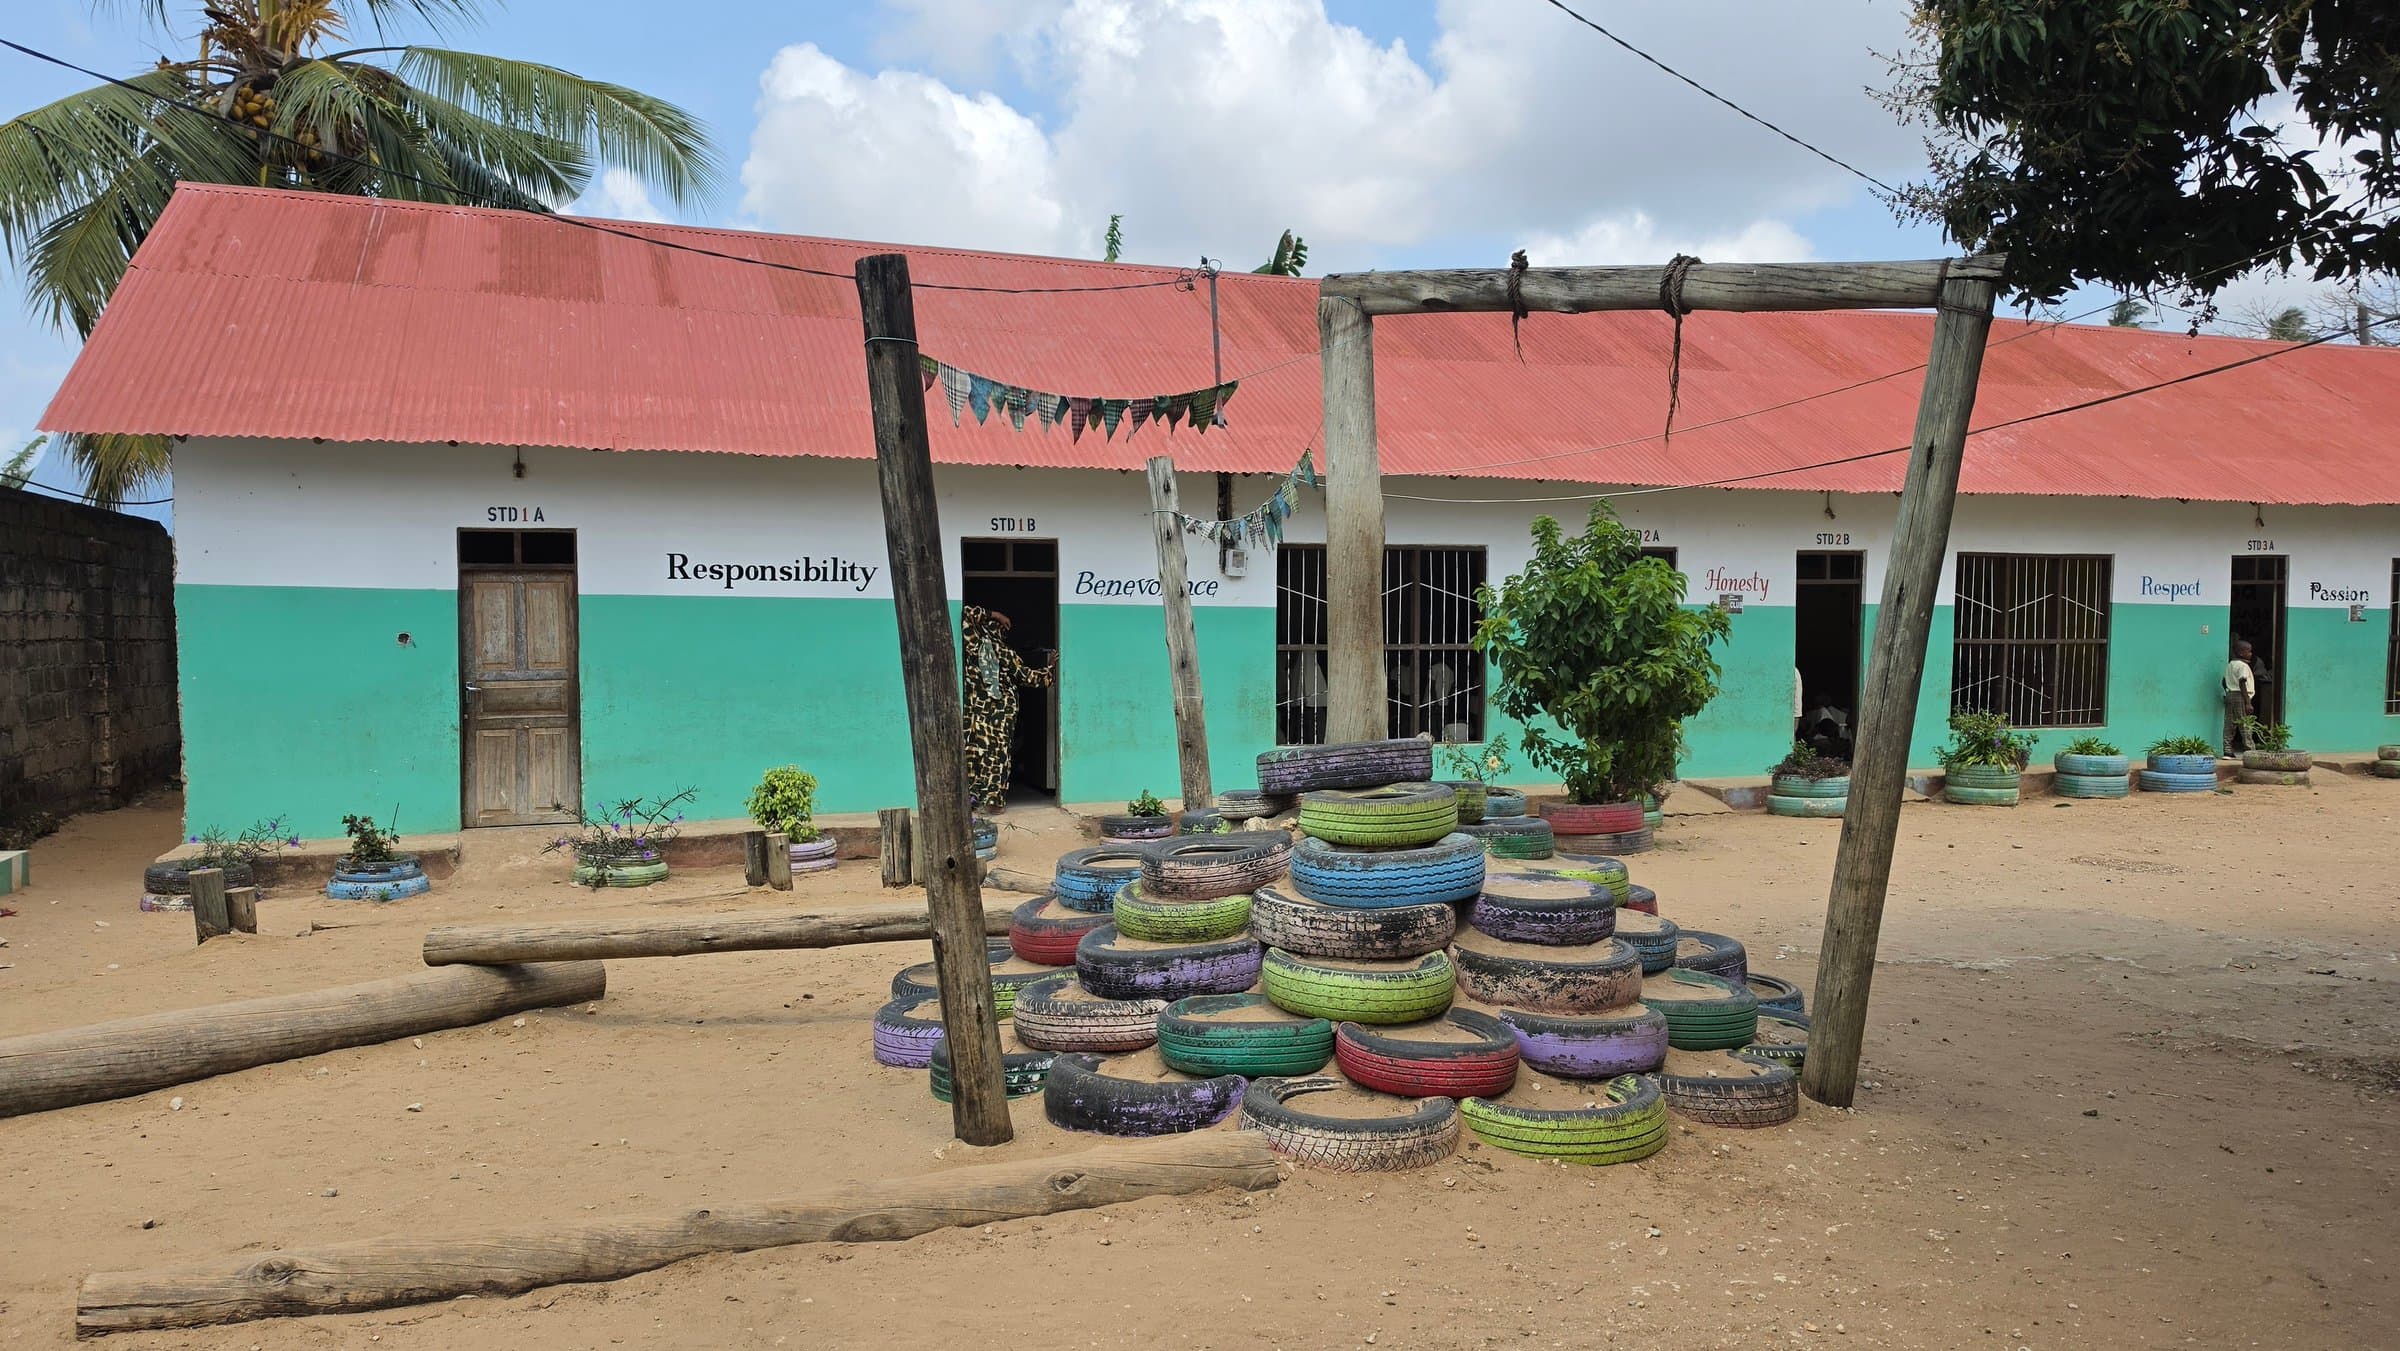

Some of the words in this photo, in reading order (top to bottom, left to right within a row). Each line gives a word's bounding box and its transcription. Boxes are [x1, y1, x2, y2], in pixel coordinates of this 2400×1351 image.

[487, 506, 518, 522] STD
[522, 506, 529, 522] 1
[533, 506, 545, 522] A
[991, 517, 1016, 532] STD
[1018, 517, 1025, 532] 1
[1027, 517, 1036, 532] B
[1644, 529, 1651, 542] 2
[1652, 529, 1660, 542] A
[1816, 533, 1834, 545] STD
[1835, 533, 1842, 545] 2
[1843, 533, 1850, 545] B
[2247, 540, 2262, 551] STD
[2262, 540, 2268, 551] 3
[2268, 540, 2275, 551] A
[666, 553, 879, 592] Responsibility
[1704, 566, 1769, 602] Honesty
[2141, 575, 2201, 602] Respect
[2309, 581, 2369, 602] Passion
